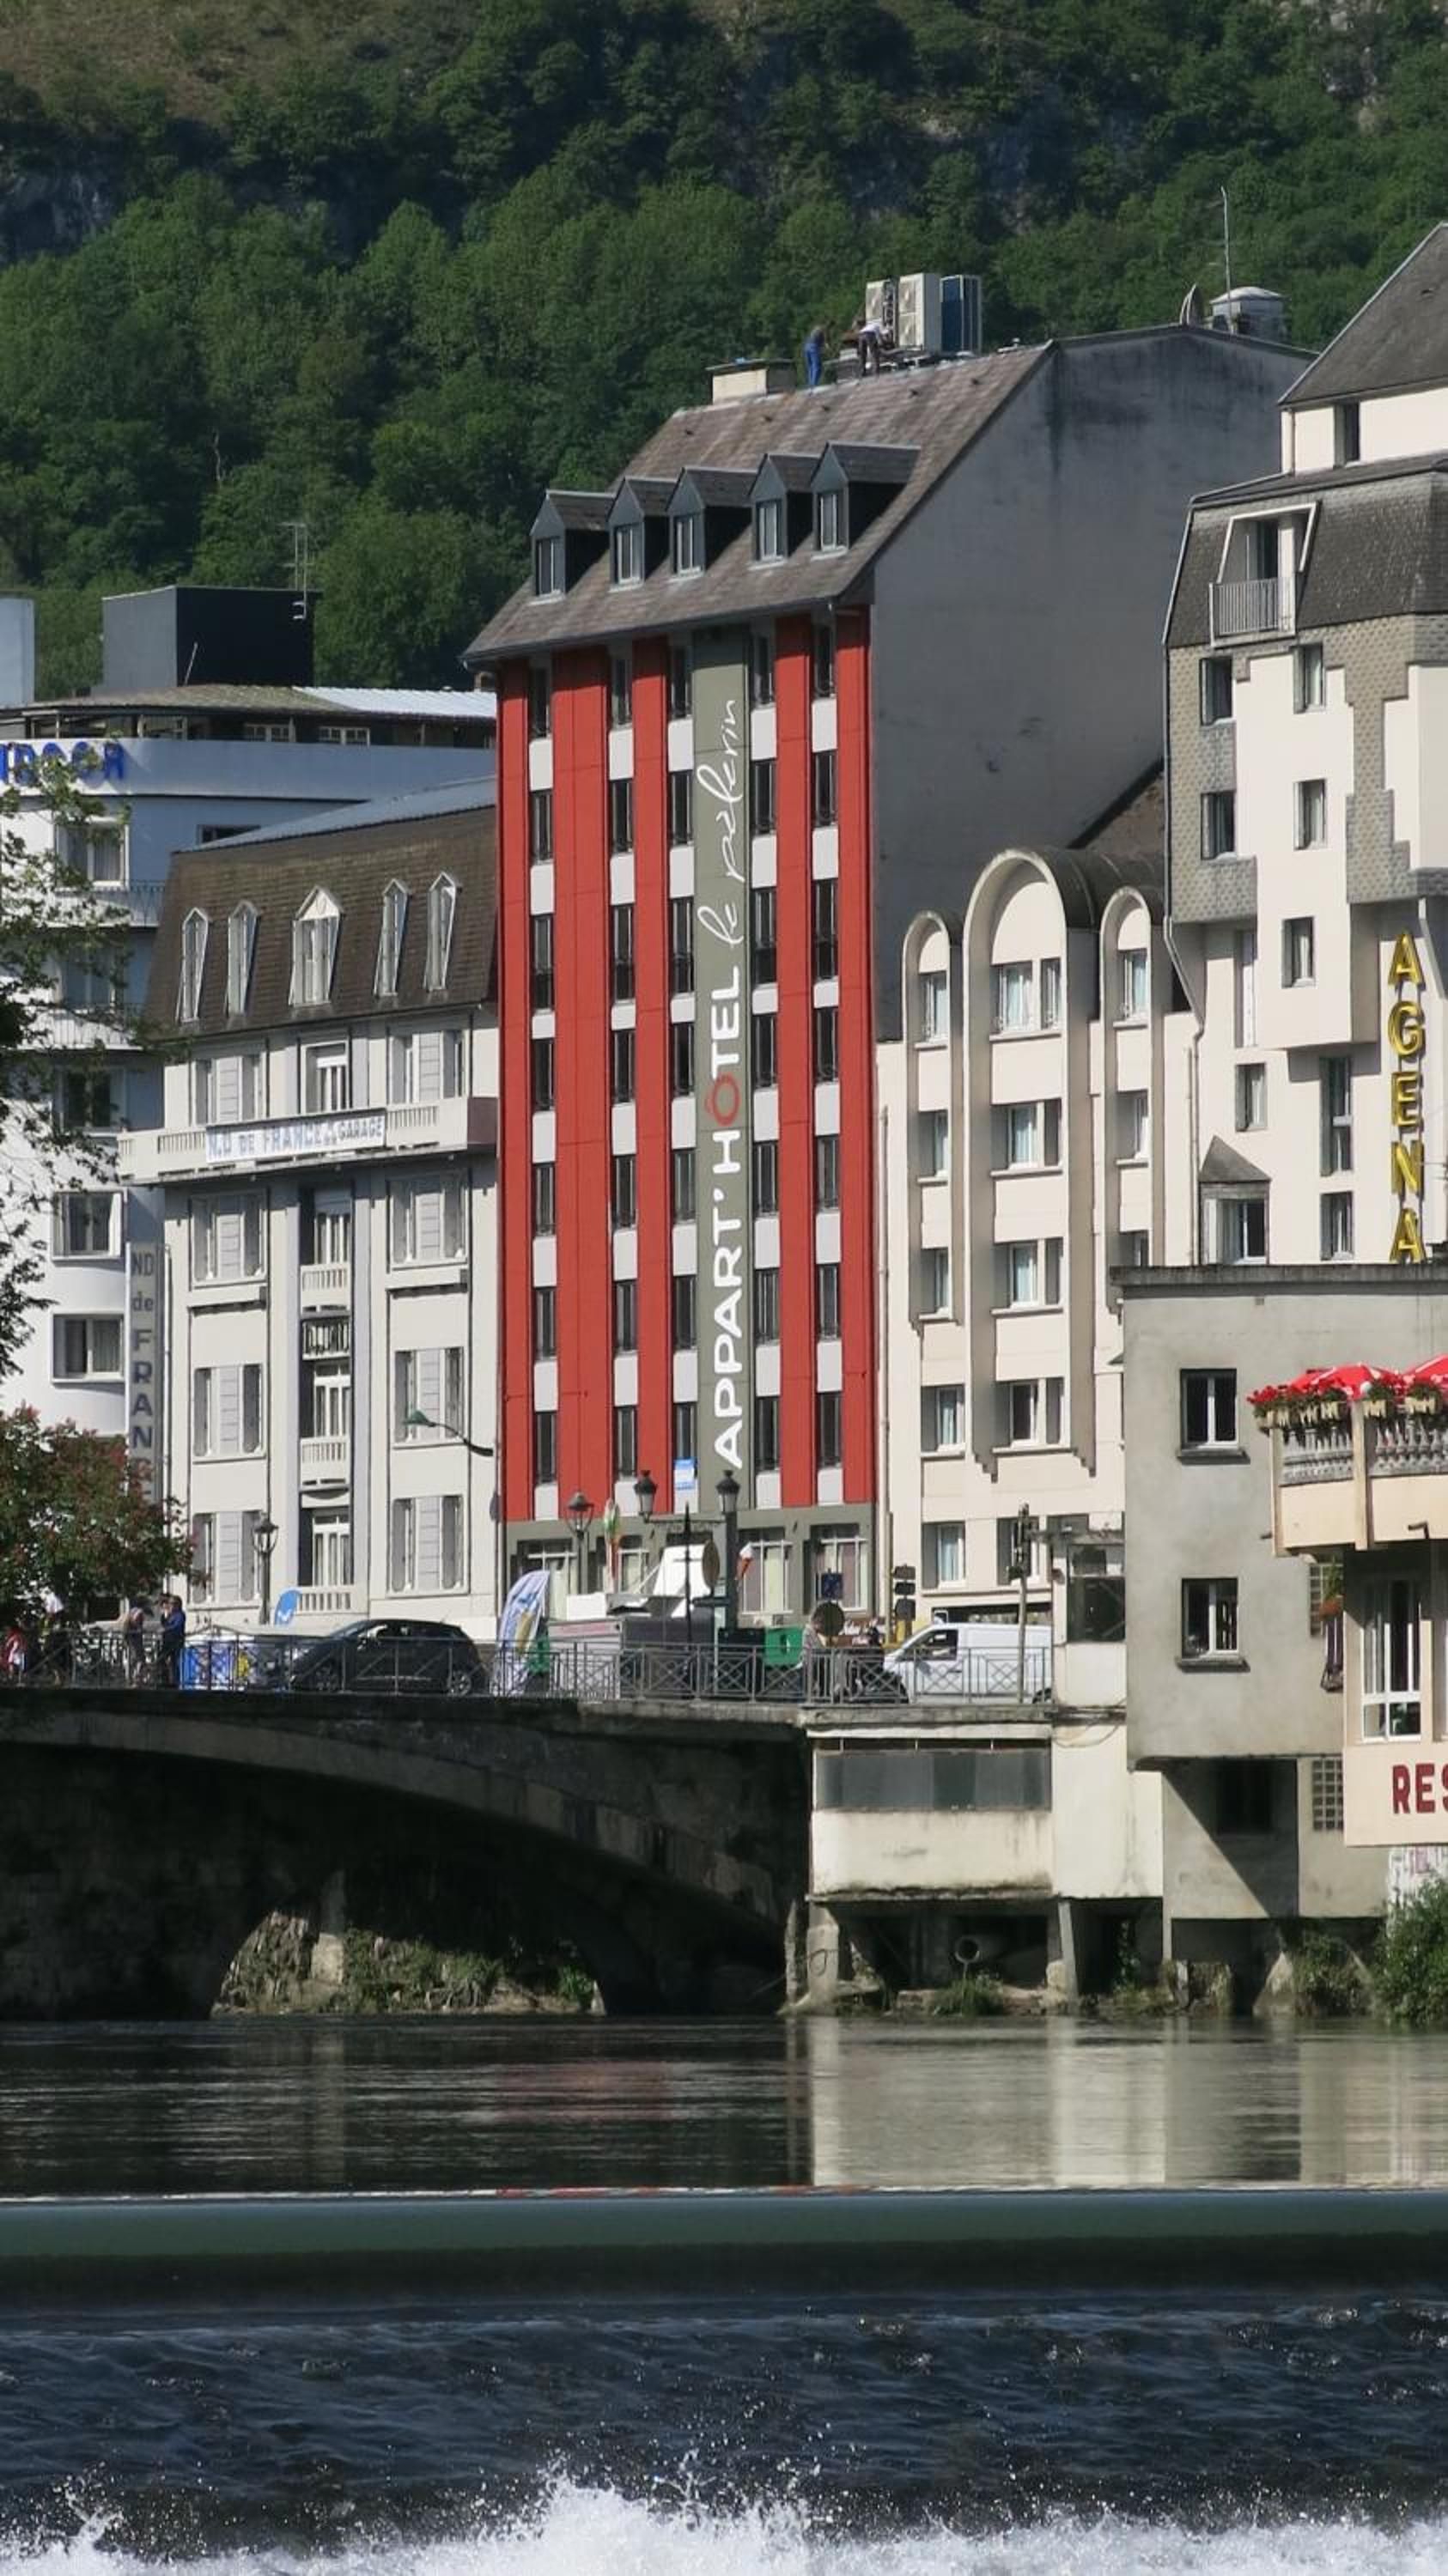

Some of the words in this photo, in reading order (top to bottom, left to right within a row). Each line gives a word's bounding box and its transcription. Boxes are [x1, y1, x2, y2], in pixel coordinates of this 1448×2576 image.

[697, 904, 744, 948] le
[1388, 931, 1423, 1263] AGENA
[338, 1115, 382, 1141] GARAGE
[132, 1291, 154, 1312] de
